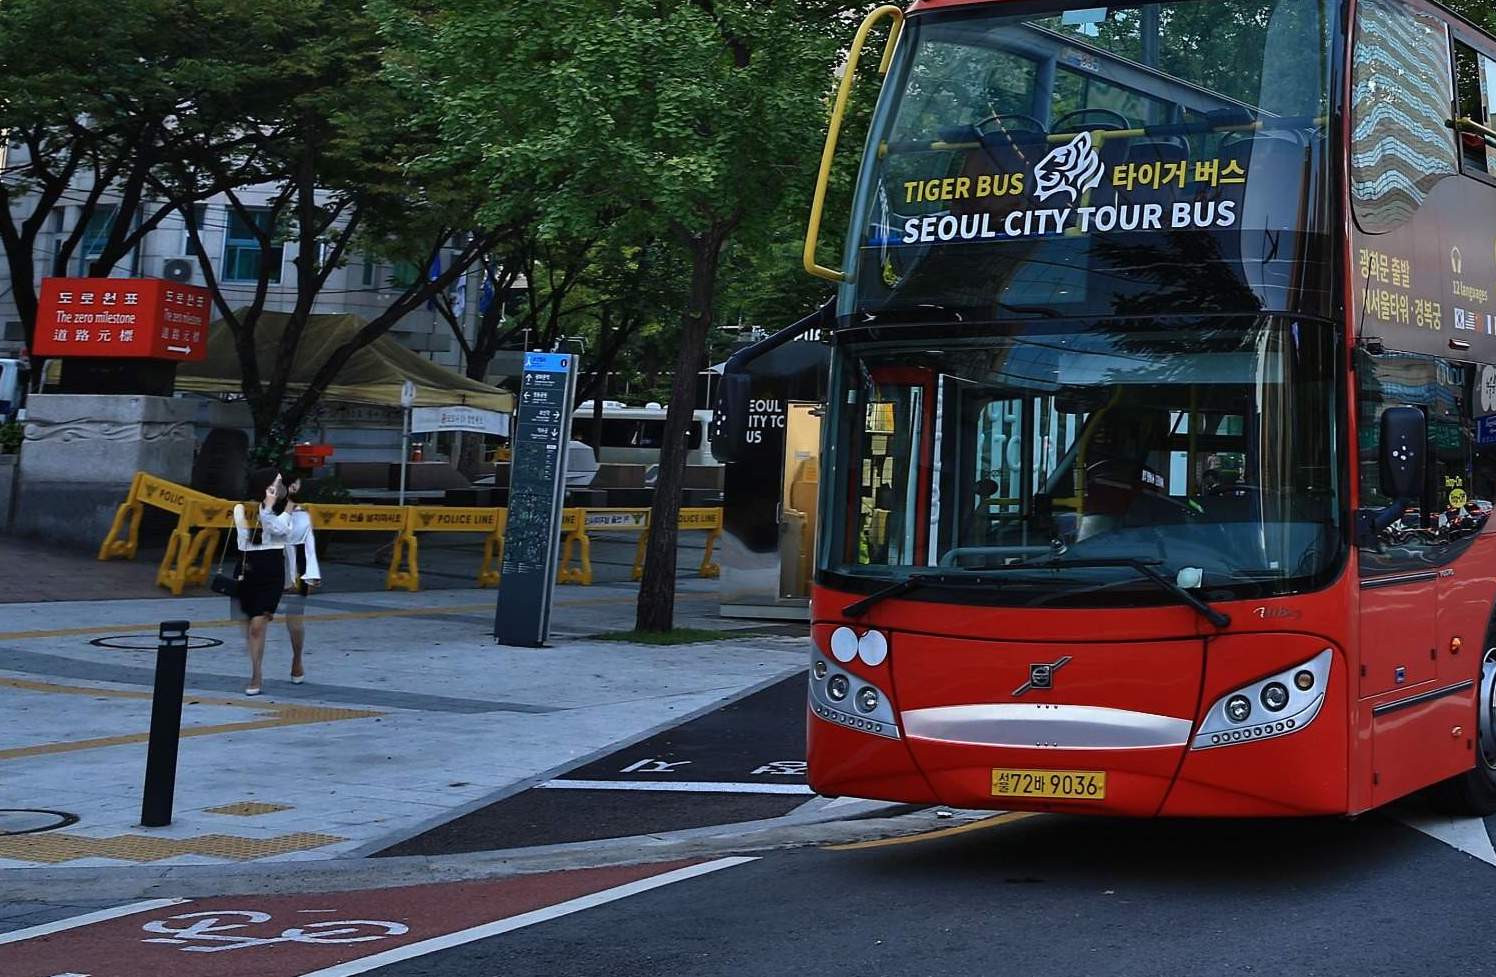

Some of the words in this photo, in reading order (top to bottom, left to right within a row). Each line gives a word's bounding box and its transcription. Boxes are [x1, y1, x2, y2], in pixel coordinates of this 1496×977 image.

[1112, 160, 1187, 191] 타이거
[1194, 159, 1246, 187] 버스
[903, 177, 969, 203] TIGER
[976, 173, 1024, 197] BUS
[902, 212, 996, 244] SEOUL
[1004, 209, 1070, 237] CITY
[1077, 204, 1162, 232] TOUR
[1171, 200, 1236, 228] BUS
[1359, 247, 1389, 284] 광화문
[1391, 256, 1410, 289] 출발
[57, 292, 139, 306] 도로원표
[1452, 280, 1459, 295] 12
[1459, 282, 1488, 304] languages
[56, 310, 73, 324] The
[74, 314, 94, 324] zero
[95, 311, 137, 324] milestone
[52, 328, 134, 342] 道路元標
[748, 415, 767, 428] ITY
[746, 430, 762, 443] US
[438, 514, 472, 525] POLICE
[474, 515, 496, 525] LINE
[998, 772, 1045, 793] 서울72바
[1050, 775, 1098, 796] 9036
